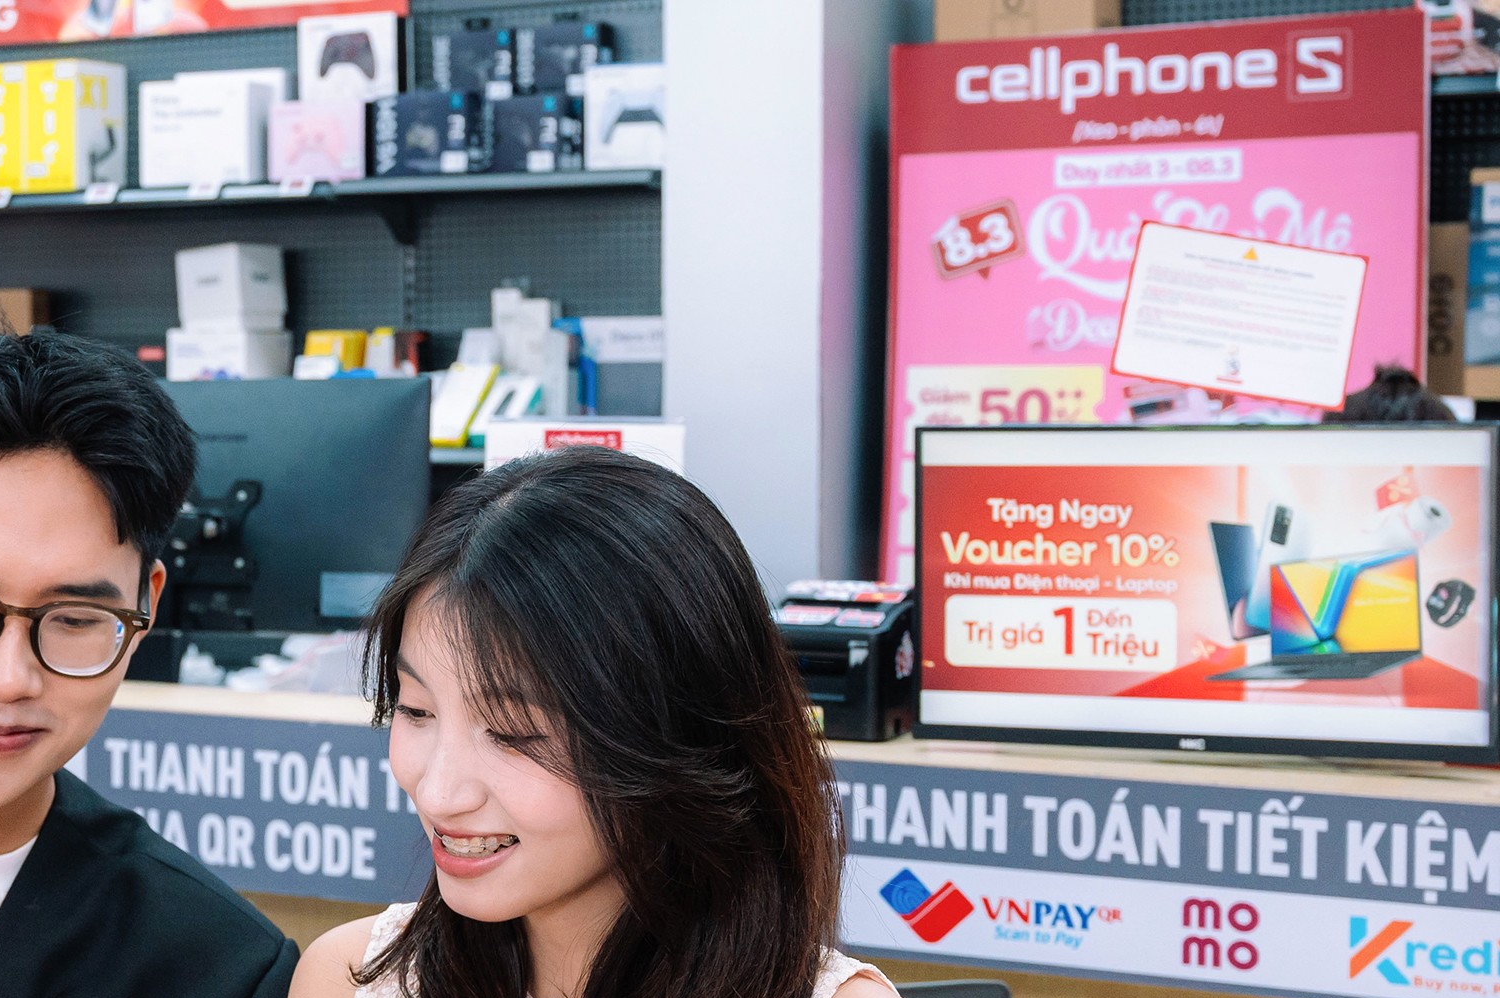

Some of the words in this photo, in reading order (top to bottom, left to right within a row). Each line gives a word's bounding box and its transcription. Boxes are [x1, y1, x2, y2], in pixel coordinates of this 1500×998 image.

[956, 42, 1277, 114] cellphone
[943, 212, 1014, 267] 8.3
[987, 498, 1053, 529] Tặng
[1059, 498, 1133, 529] Ngay
[940, 531, 1097, 566] Voucher
[1105, 533, 1180, 567] 10%
[944, 572, 970, 589] Khi
[973, 575, 1011, 590] mua
[1115, 575, 1178, 594] Laptop
[964, 621, 994, 650] Trị
[1002, 622, 1044, 650] giá
[1053, 606, 1074, 656] 1
[1086, 608, 1132, 628] Đến
[1087, 633, 1159, 664] Triệu
[104, 737, 245, 799] THANH
[253, 741, 369, 810] TOÁN
[198, 813, 255, 870] QR
[264, 818, 377, 881] CODE
[1023, 787, 1181, 868] TOÁN
[1197, 795, 1329, 880] TIẾT
[1345, 810, 1500, 904] KIỆM
[994, 925, 1031, 942] Scan
[1035, 929, 1050, 943] to
[1054, 931, 1083, 949] Pay
[1349, 916, 1500, 986] Kred
[1413, 976, 1443, 993] Buy
[1450, 982, 1487, 996] now,
